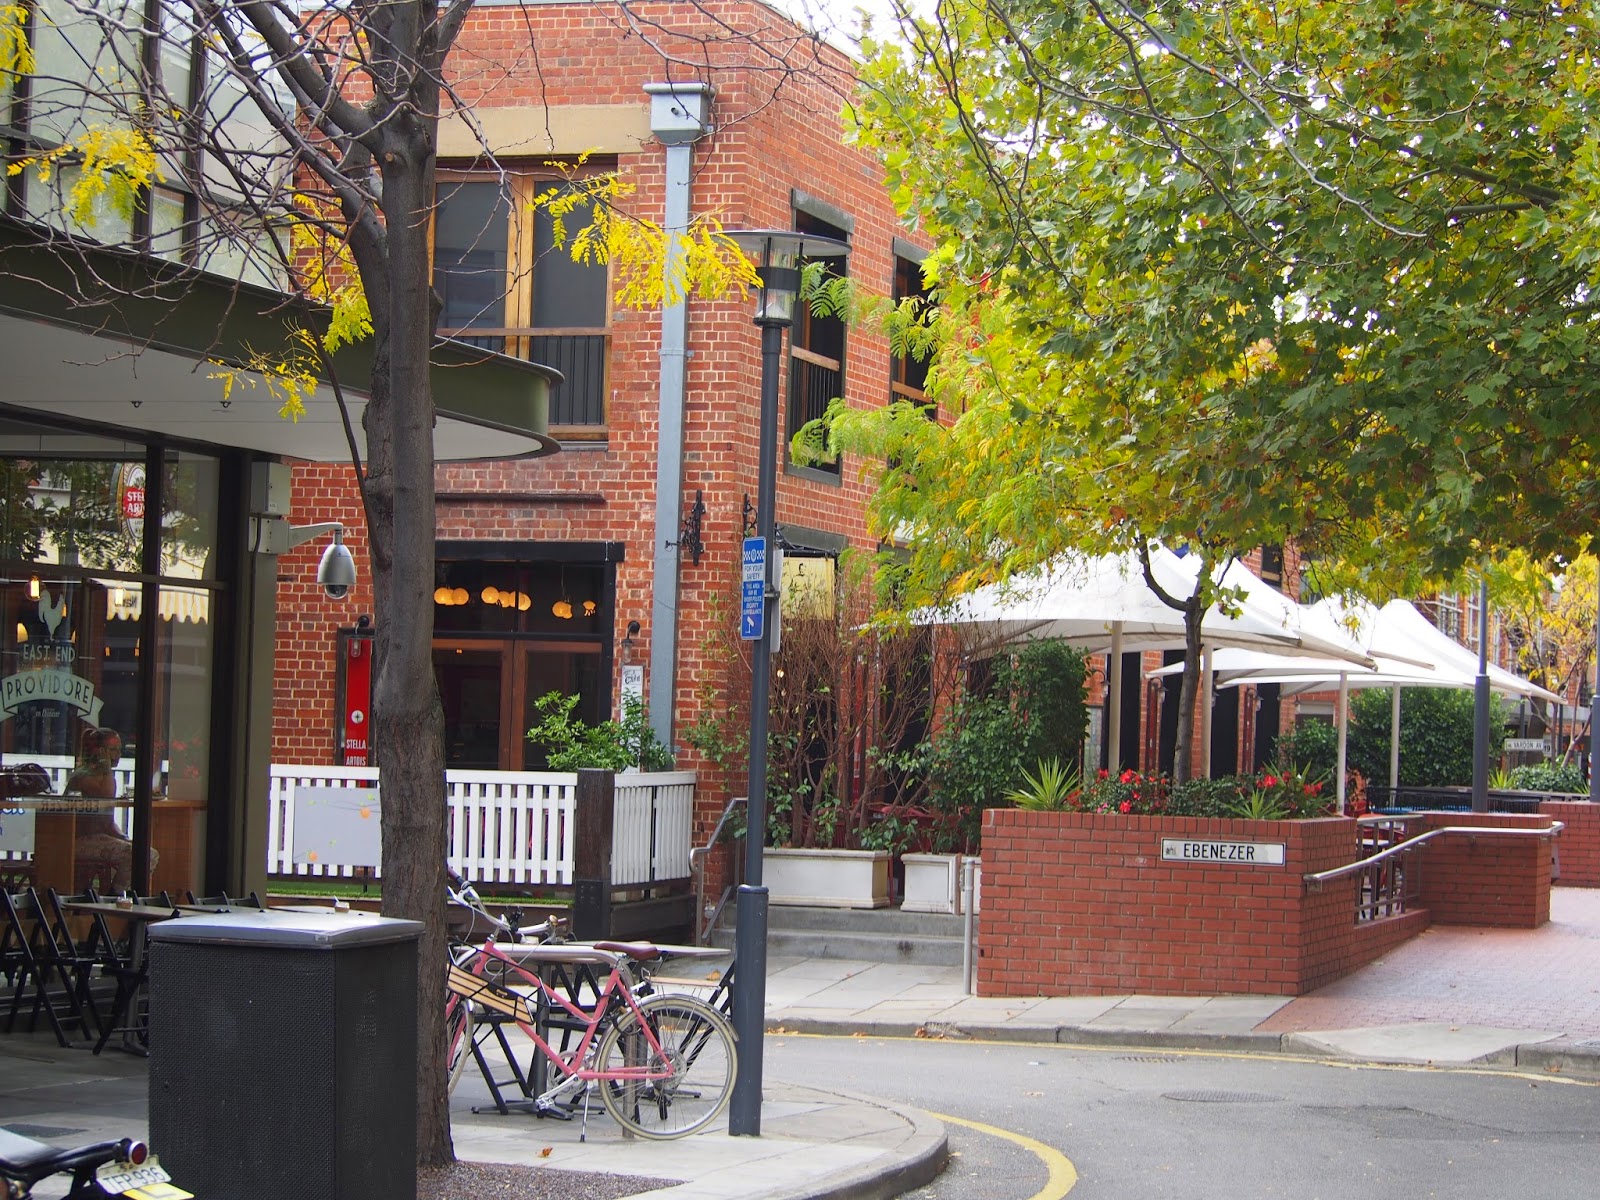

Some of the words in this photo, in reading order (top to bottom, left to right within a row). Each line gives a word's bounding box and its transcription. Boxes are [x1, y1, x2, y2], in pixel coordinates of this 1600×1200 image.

[23, 643, 51, 660] EAST
[55, 646, 76, 662] END
[6, 674, 90, 704] PROVIDORE
[346, 739, 366, 749] STELLA
[346, 755, 366, 766] ARTOIS
[1183, 843, 1255, 861] EBENEZER
[132, 1167, 166, 1184] 936
